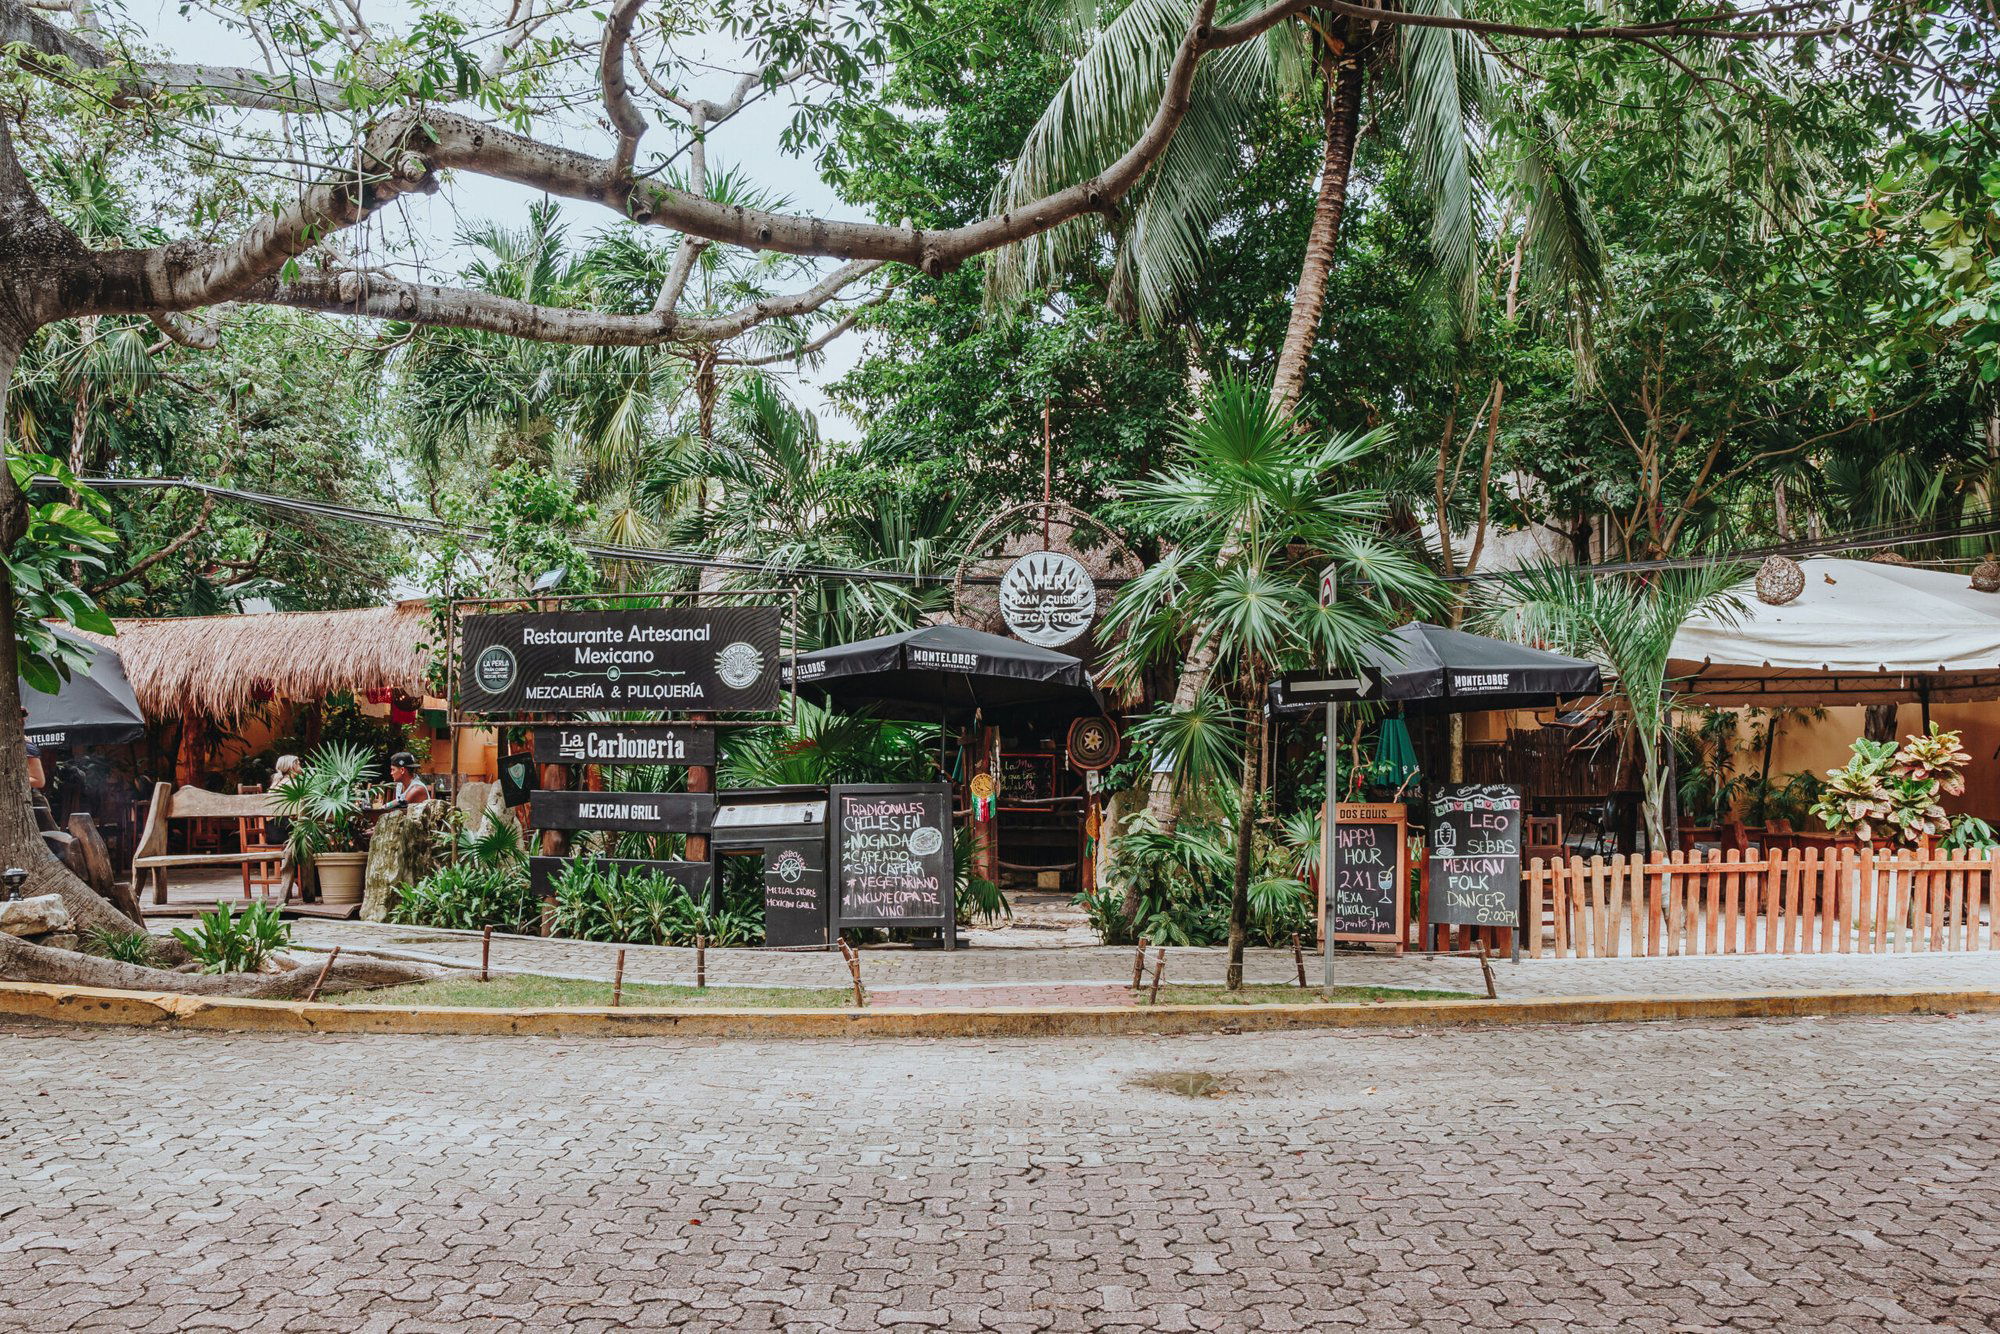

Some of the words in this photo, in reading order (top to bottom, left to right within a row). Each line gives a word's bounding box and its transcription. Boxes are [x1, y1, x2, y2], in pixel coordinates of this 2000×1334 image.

[1034, 574, 1088, 592] PERLA
[1009, 595, 1039, 605] PIXAN
[1046, 595, 1084, 605] CUISINE
[1052, 613, 1082, 623] STORE
[523, 627, 623, 645] Restaurante
[627, 624, 710, 642] Artesanal
[574, 647, 654, 664] Mexicano
[914, 650, 977, 666] MONTELOBOS
[781, 661, 826, 678] MOTELOBOS
[1454, 673, 1509, 688] MONTELOBOS
[526, 683, 604, 699] MEZCALERÍA
[611, 685, 621, 698] &
[628, 682, 704, 699] PULQUERÍA
[560, 731, 584, 748] La
[579, 803, 629, 820] MEXICAN
[631, 805, 661, 820] GRILL
[1340, 809, 1358, 819] DOS
[1360, 809, 1388, 819] EQUIS
[844, 815, 901, 832] CHILES
[904, 813, 921, 830] EN
[1469, 814, 1509, 831] LEO
[851, 832, 911, 851] NOGADA
[851, 850, 909, 862] CAPEADO
[1345, 848, 1384, 867] HOUR
[1443, 858, 1505, 876] MEXICAN
[859, 876, 939, 890] VEGETARIANO
[1449, 875, 1490, 892] FOLK
[922, 892, 940, 904] DE
[1337, 889, 1363, 904] MEXA
[1446, 890, 1506, 910] DANCER
[877, 905, 904, 917] VINO
